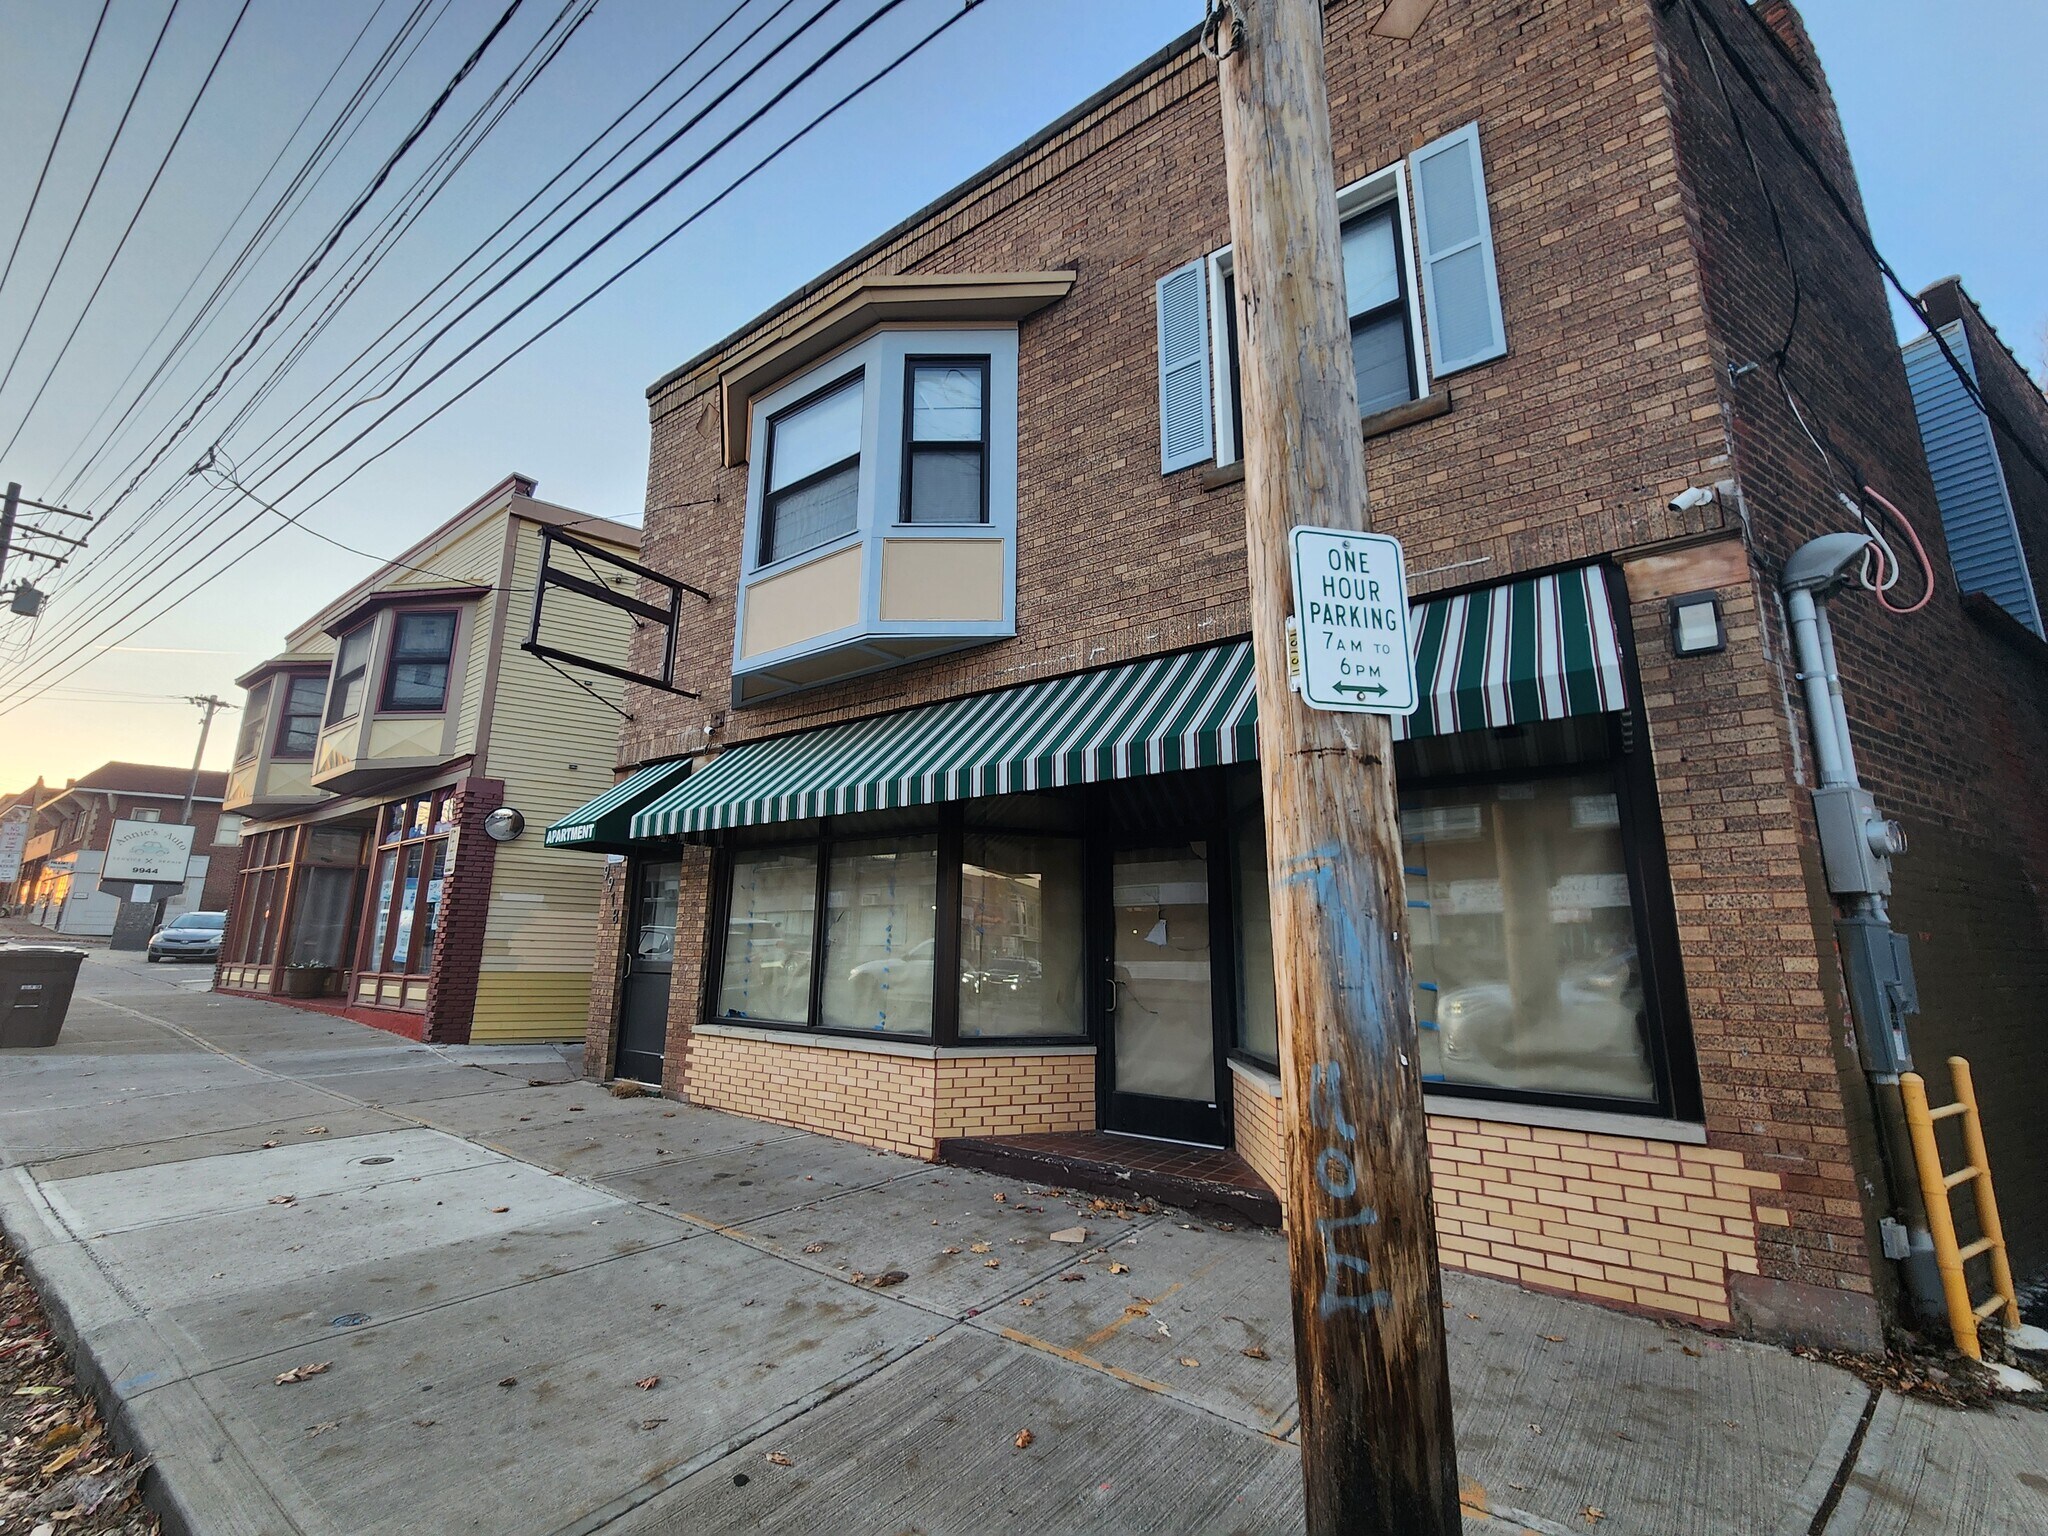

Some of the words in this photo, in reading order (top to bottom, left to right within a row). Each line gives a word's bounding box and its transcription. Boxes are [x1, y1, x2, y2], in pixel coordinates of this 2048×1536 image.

[1328, 549, 1370, 573] ONE
[1322, 575, 1380, 601] HOUR
[1310, 601, 1397, 631] PARKING
[1322, 631, 1363, 653] 7AM
[1374, 644, 1390, 655] TO
[1341, 658, 1381, 677] 6PM
[116, 828, 159, 846] Annie's
[164, 832, 187, 852] Auto
[546, 824, 595, 844] APARTMENT
